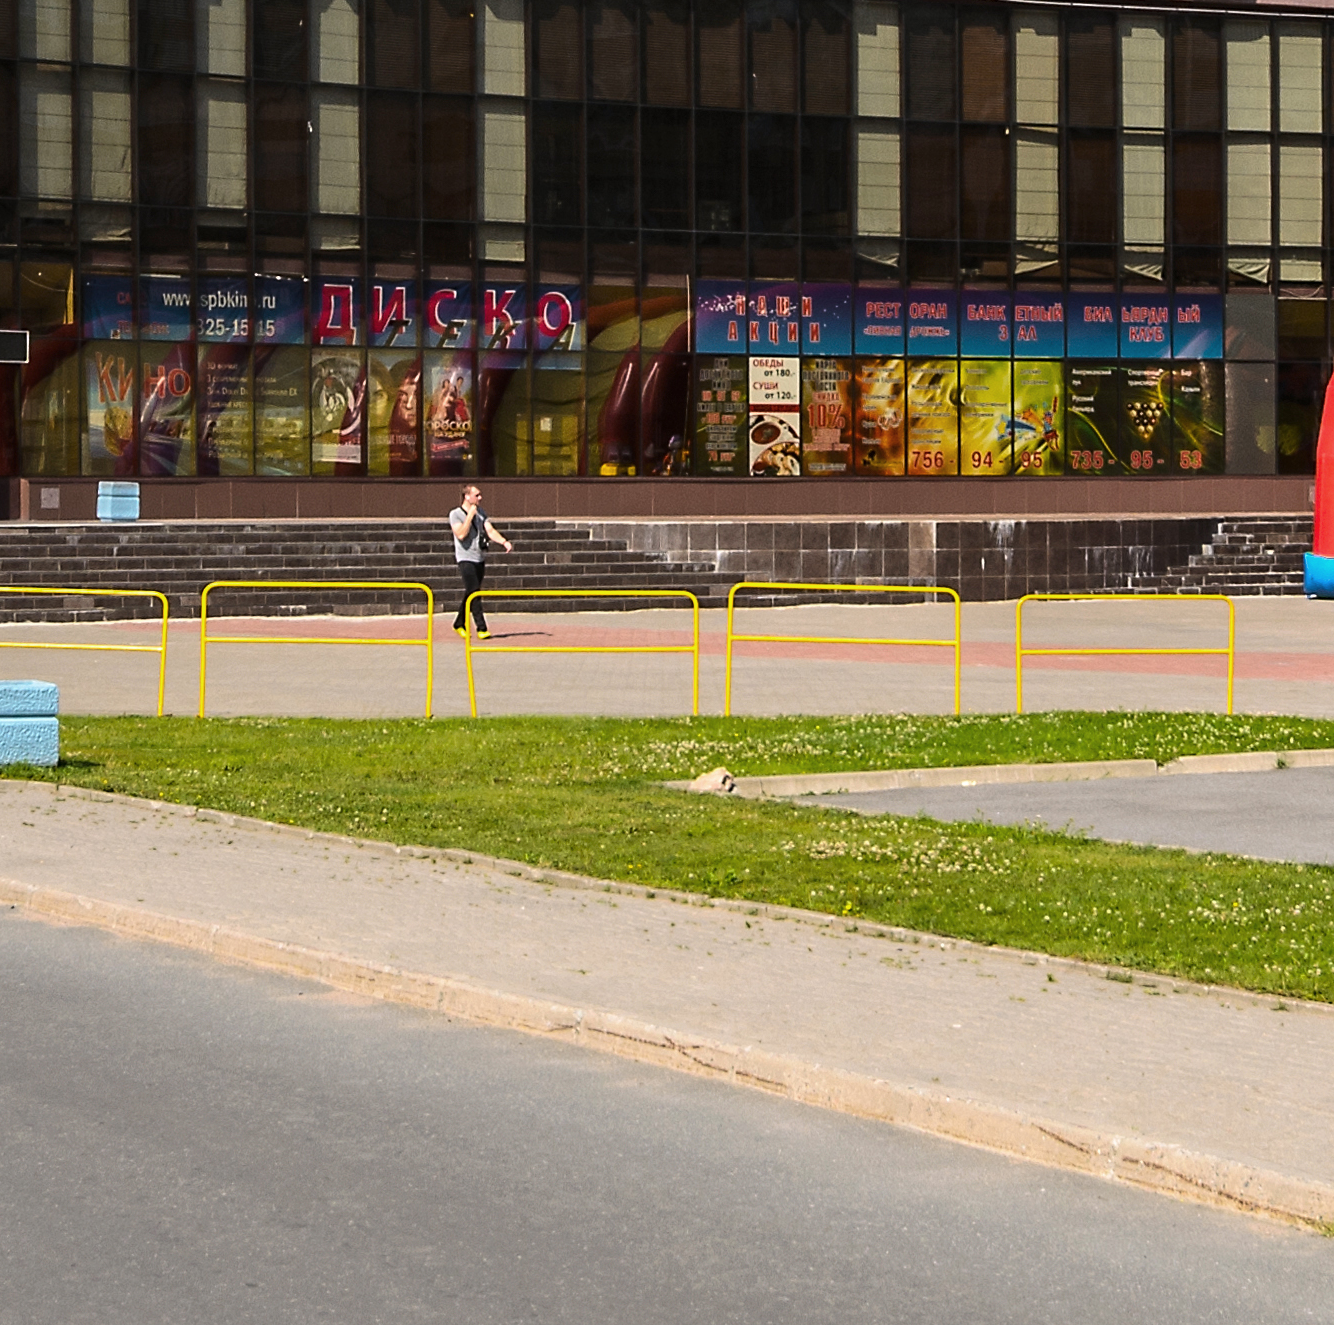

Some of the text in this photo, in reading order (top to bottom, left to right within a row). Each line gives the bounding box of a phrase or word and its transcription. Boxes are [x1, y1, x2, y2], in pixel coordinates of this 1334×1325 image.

[162, 290, 276, 312] wwwspbkin.ru
[735, 294, 813, 318] НАШИ
[865, 301, 948, 319] РЕСТОРАН
[312, 283, 573, 347] ДИСКО
[967, 303, 1064, 322] БАНКЕТНЫЙ
[1083, 304, 1202, 325] БИЛЬЯРДНЫЙ
[198, 318, 276, 338] 325-1515
[728, 320, 820, 346] АКЦИИ
[998, 326, 1037, 341] ЗАЛ
[1129, 326, 1166, 343] КЛУБ
[753, 359, 784, 368] ОБЕДЫ
[95, 350, 191, 404] КИНО
[753, 382, 778, 390] СУШИ
[807, 403, 845, 429] 10%
[911, 451, 1044, 469] 756 94 95
[1071, 450, 1203, 470] 735 95 53
